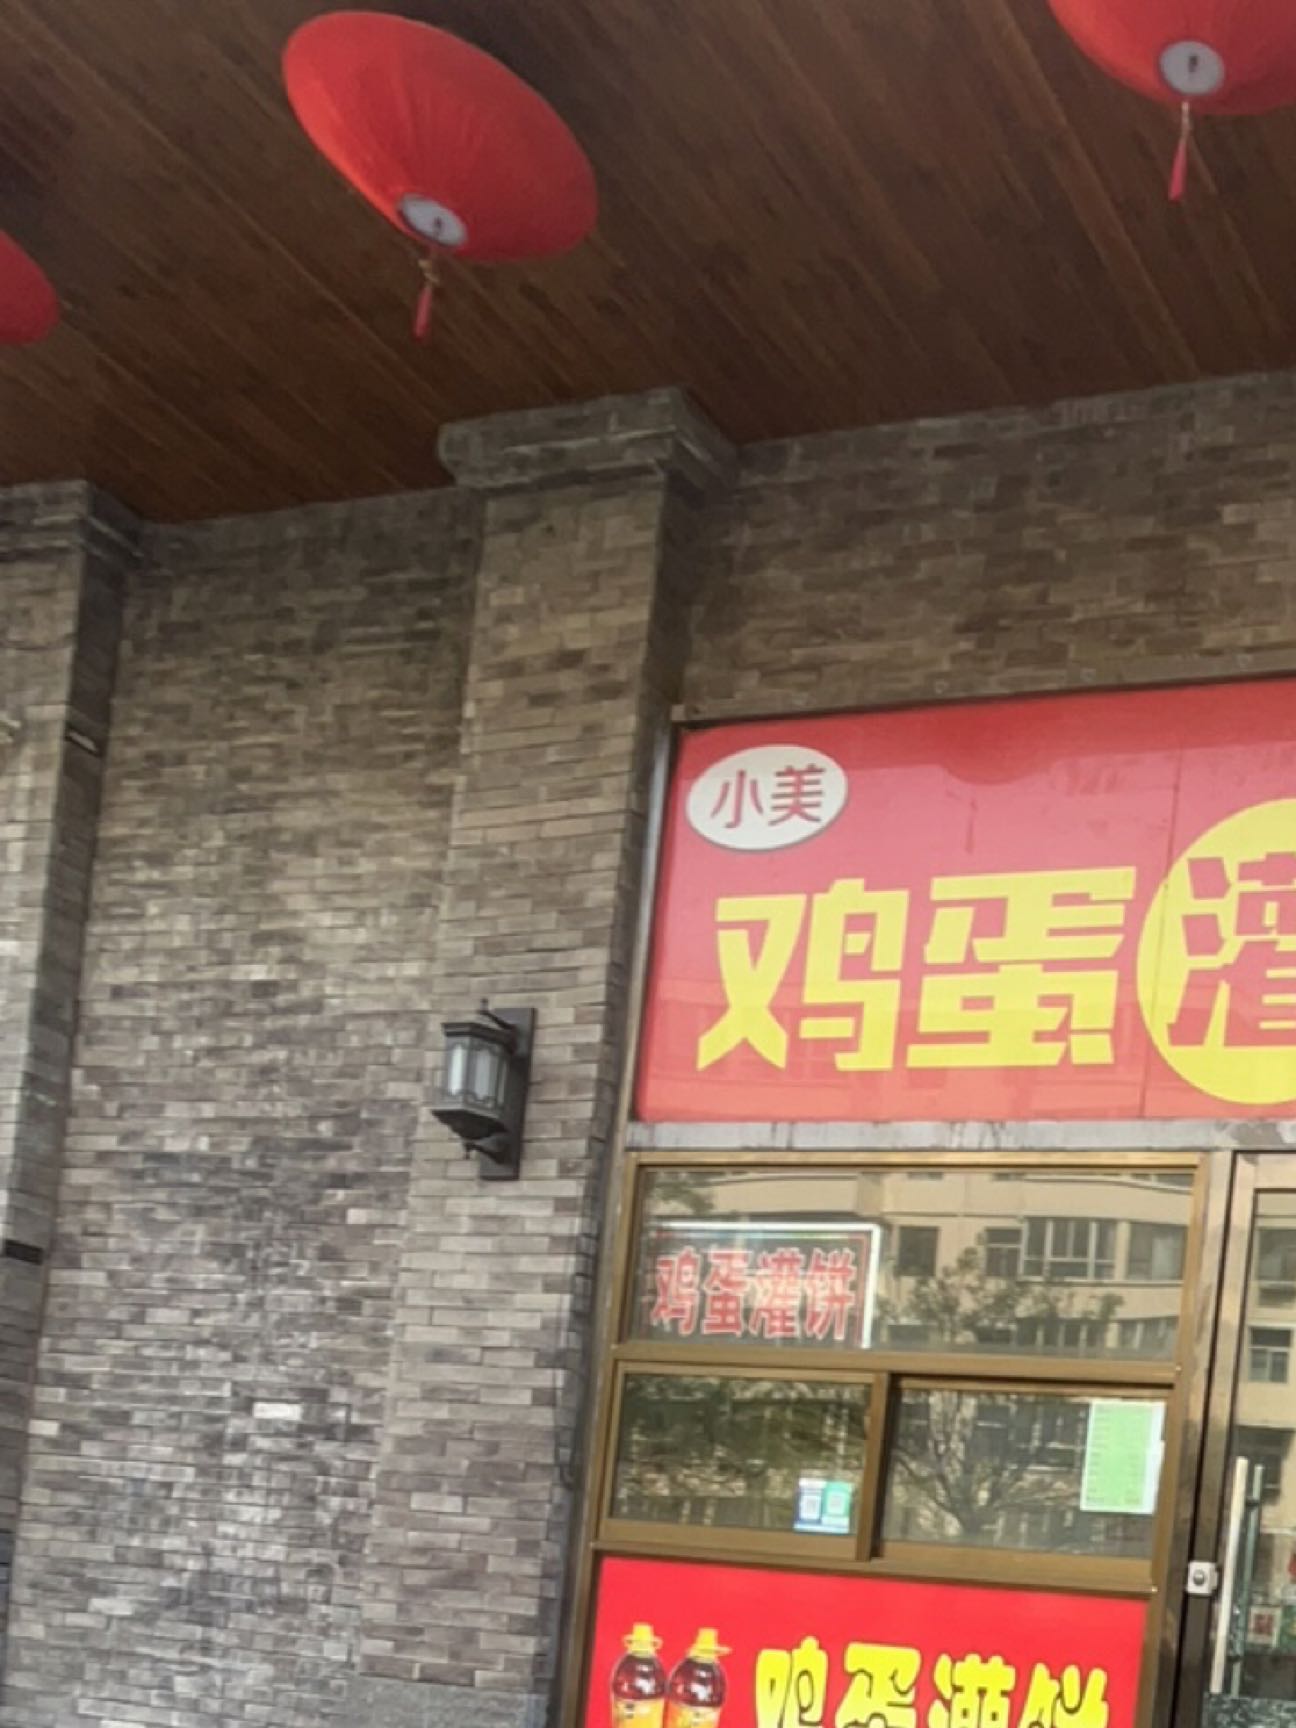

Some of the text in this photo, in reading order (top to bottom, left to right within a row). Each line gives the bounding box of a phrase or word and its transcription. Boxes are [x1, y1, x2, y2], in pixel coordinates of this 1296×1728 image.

[713, 764, 827, 829] 小美
[650, 1245, 858, 1340] 鸡蛋灌饼
